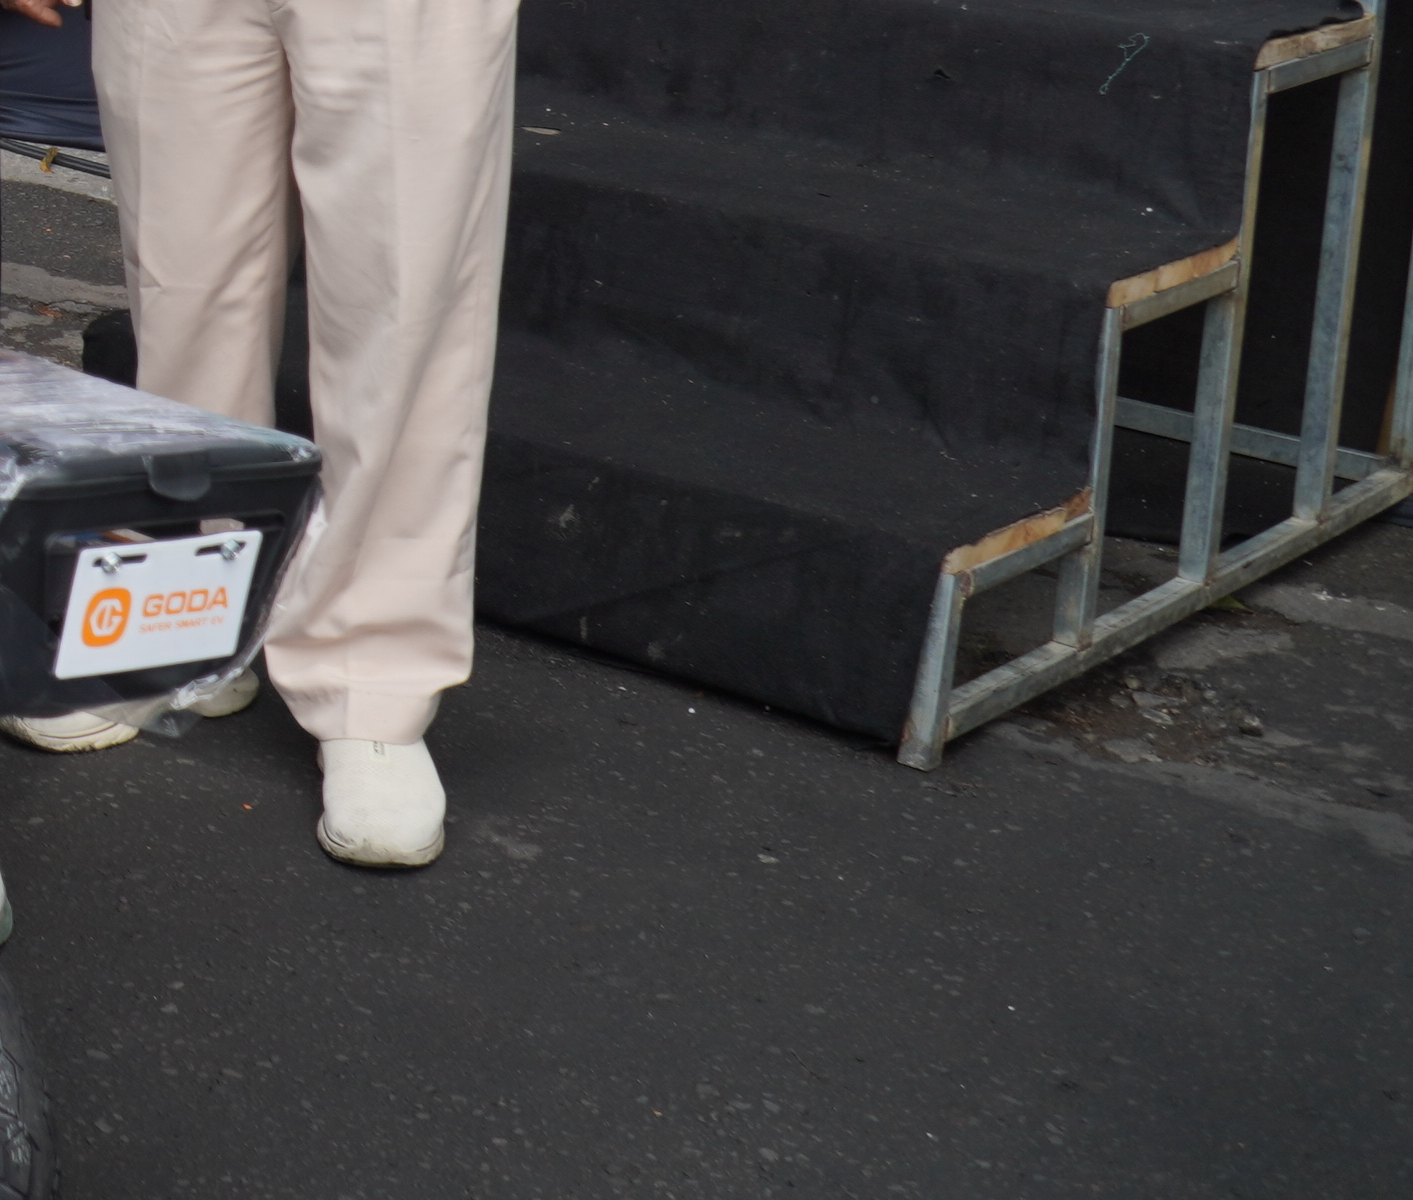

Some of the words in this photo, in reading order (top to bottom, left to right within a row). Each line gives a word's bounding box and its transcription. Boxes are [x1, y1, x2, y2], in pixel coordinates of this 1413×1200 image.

[142, 586, 228, 618] GODA
[139, 621, 171, 634] SAFER
[175, 617, 207, 631] SMART
